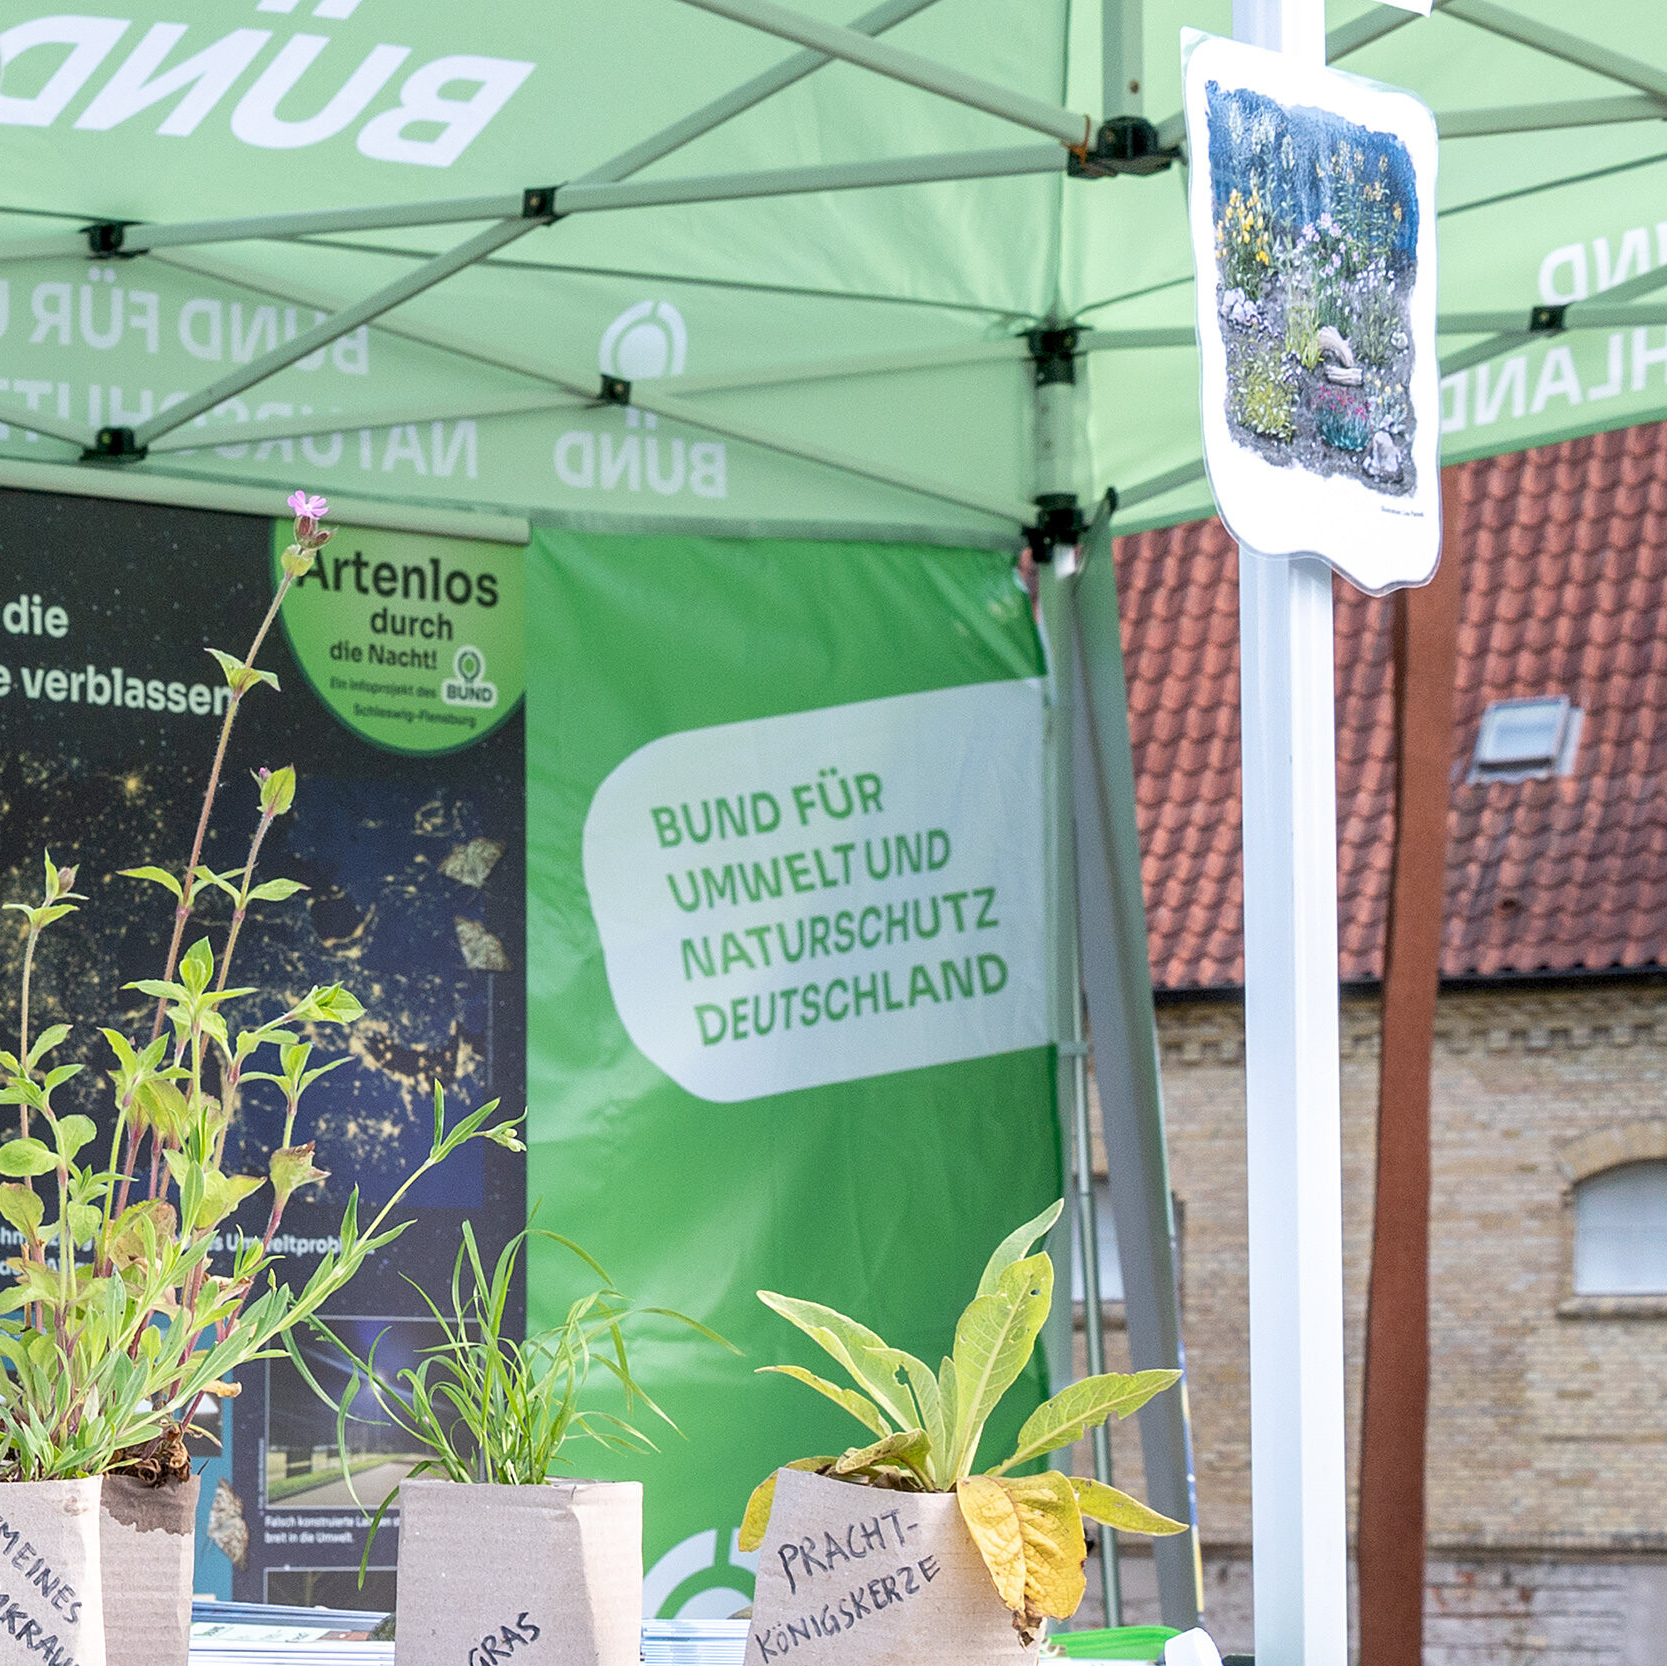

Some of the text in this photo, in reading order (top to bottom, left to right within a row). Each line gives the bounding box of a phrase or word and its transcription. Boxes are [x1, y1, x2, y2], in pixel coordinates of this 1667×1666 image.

[297, 550, 500, 609] Artenlos
[3, 595, 69, 638] die
[370, 609, 454, 641] durch
[330, 640, 437, 671] die Nacht!
[21, 667, 235, 717] verblassen
[446, 684, 493, 702] BUND
[650, 766, 884, 849] BUND FÜR
[667, 828, 952, 913] UMWELT UND
[681, 887, 999, 981] NATURSCHUTZ
[694, 953, 1008, 1047] DEUTSCHLAND
[778, 1508, 919, 1595] PRACHT-
[755, 1555, 941, 1664] KÖNIGSKERZE
